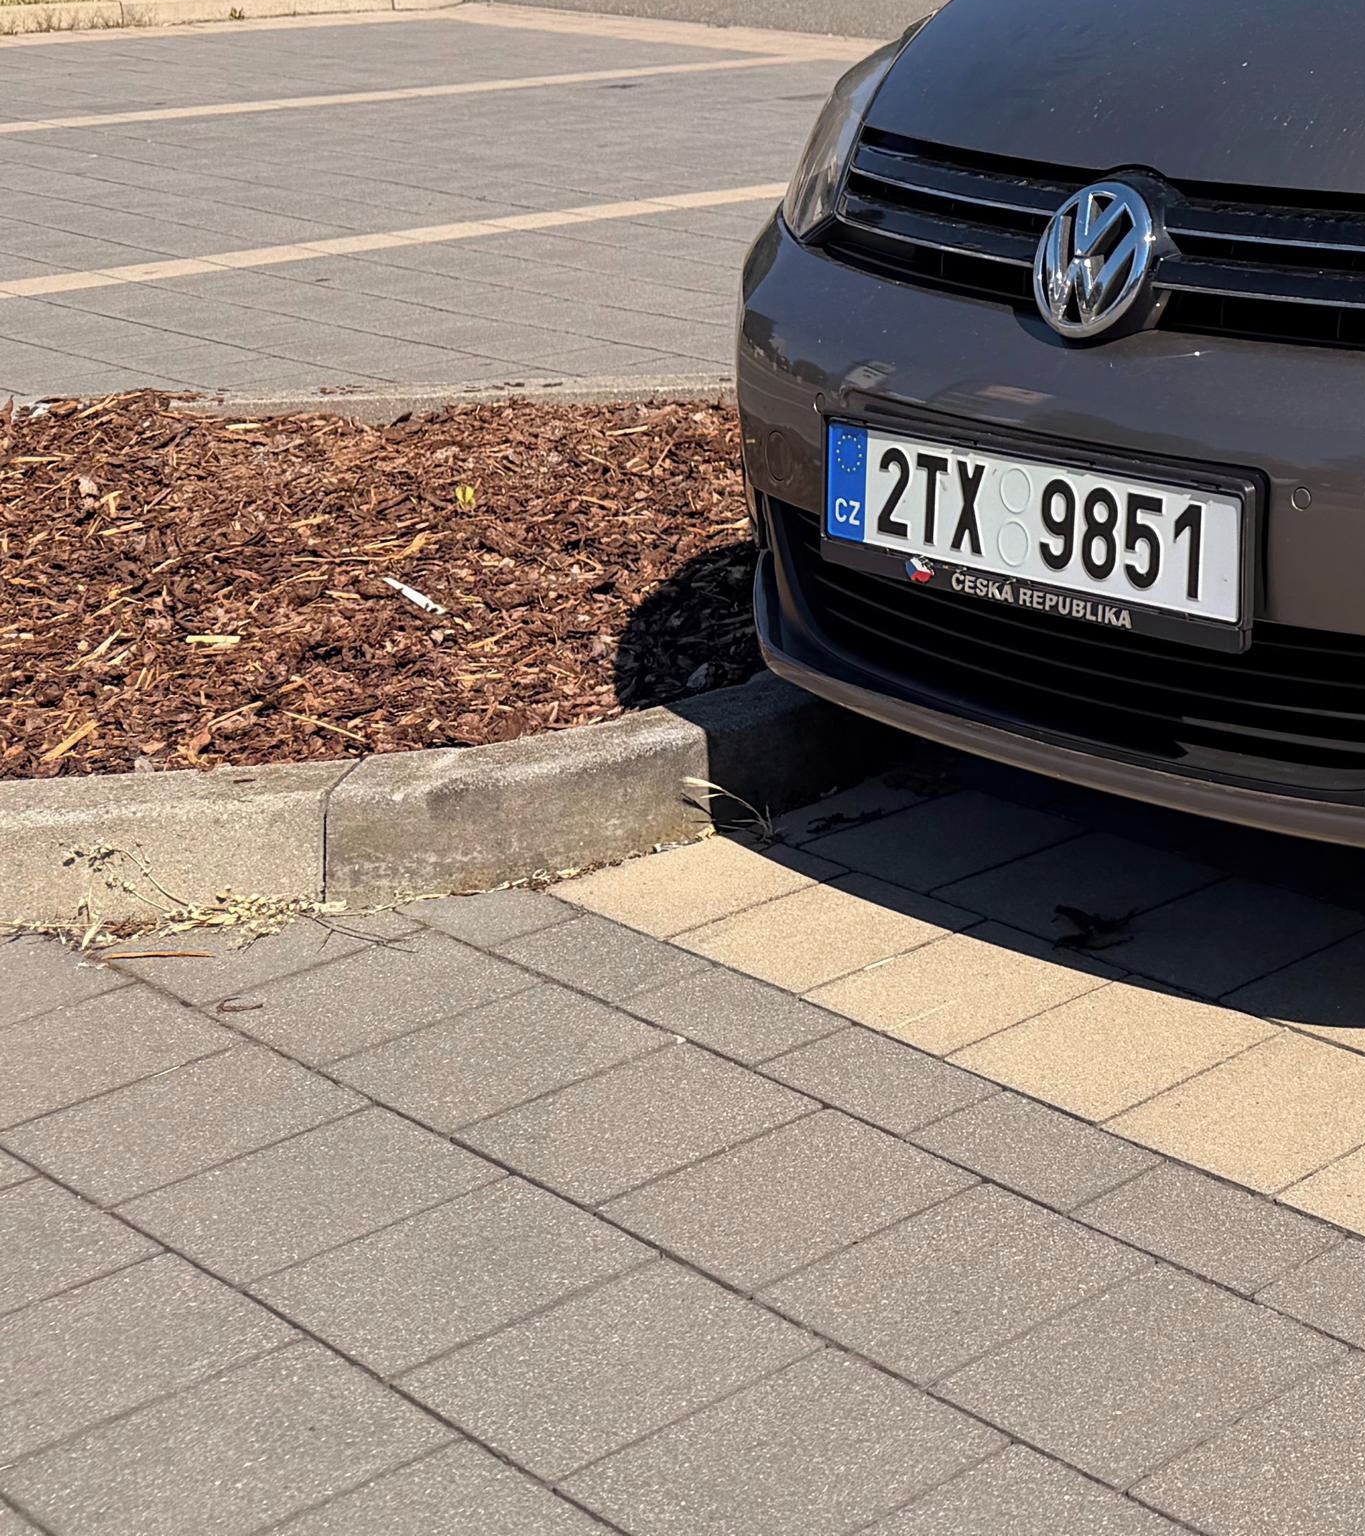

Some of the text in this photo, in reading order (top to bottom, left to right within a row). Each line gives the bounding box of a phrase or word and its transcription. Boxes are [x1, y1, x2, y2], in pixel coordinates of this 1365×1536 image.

[834, 446, 1203, 602] CZ 2TX 9851
[951, 570, 1133, 630] ČESKÁ REPUBLIKA
